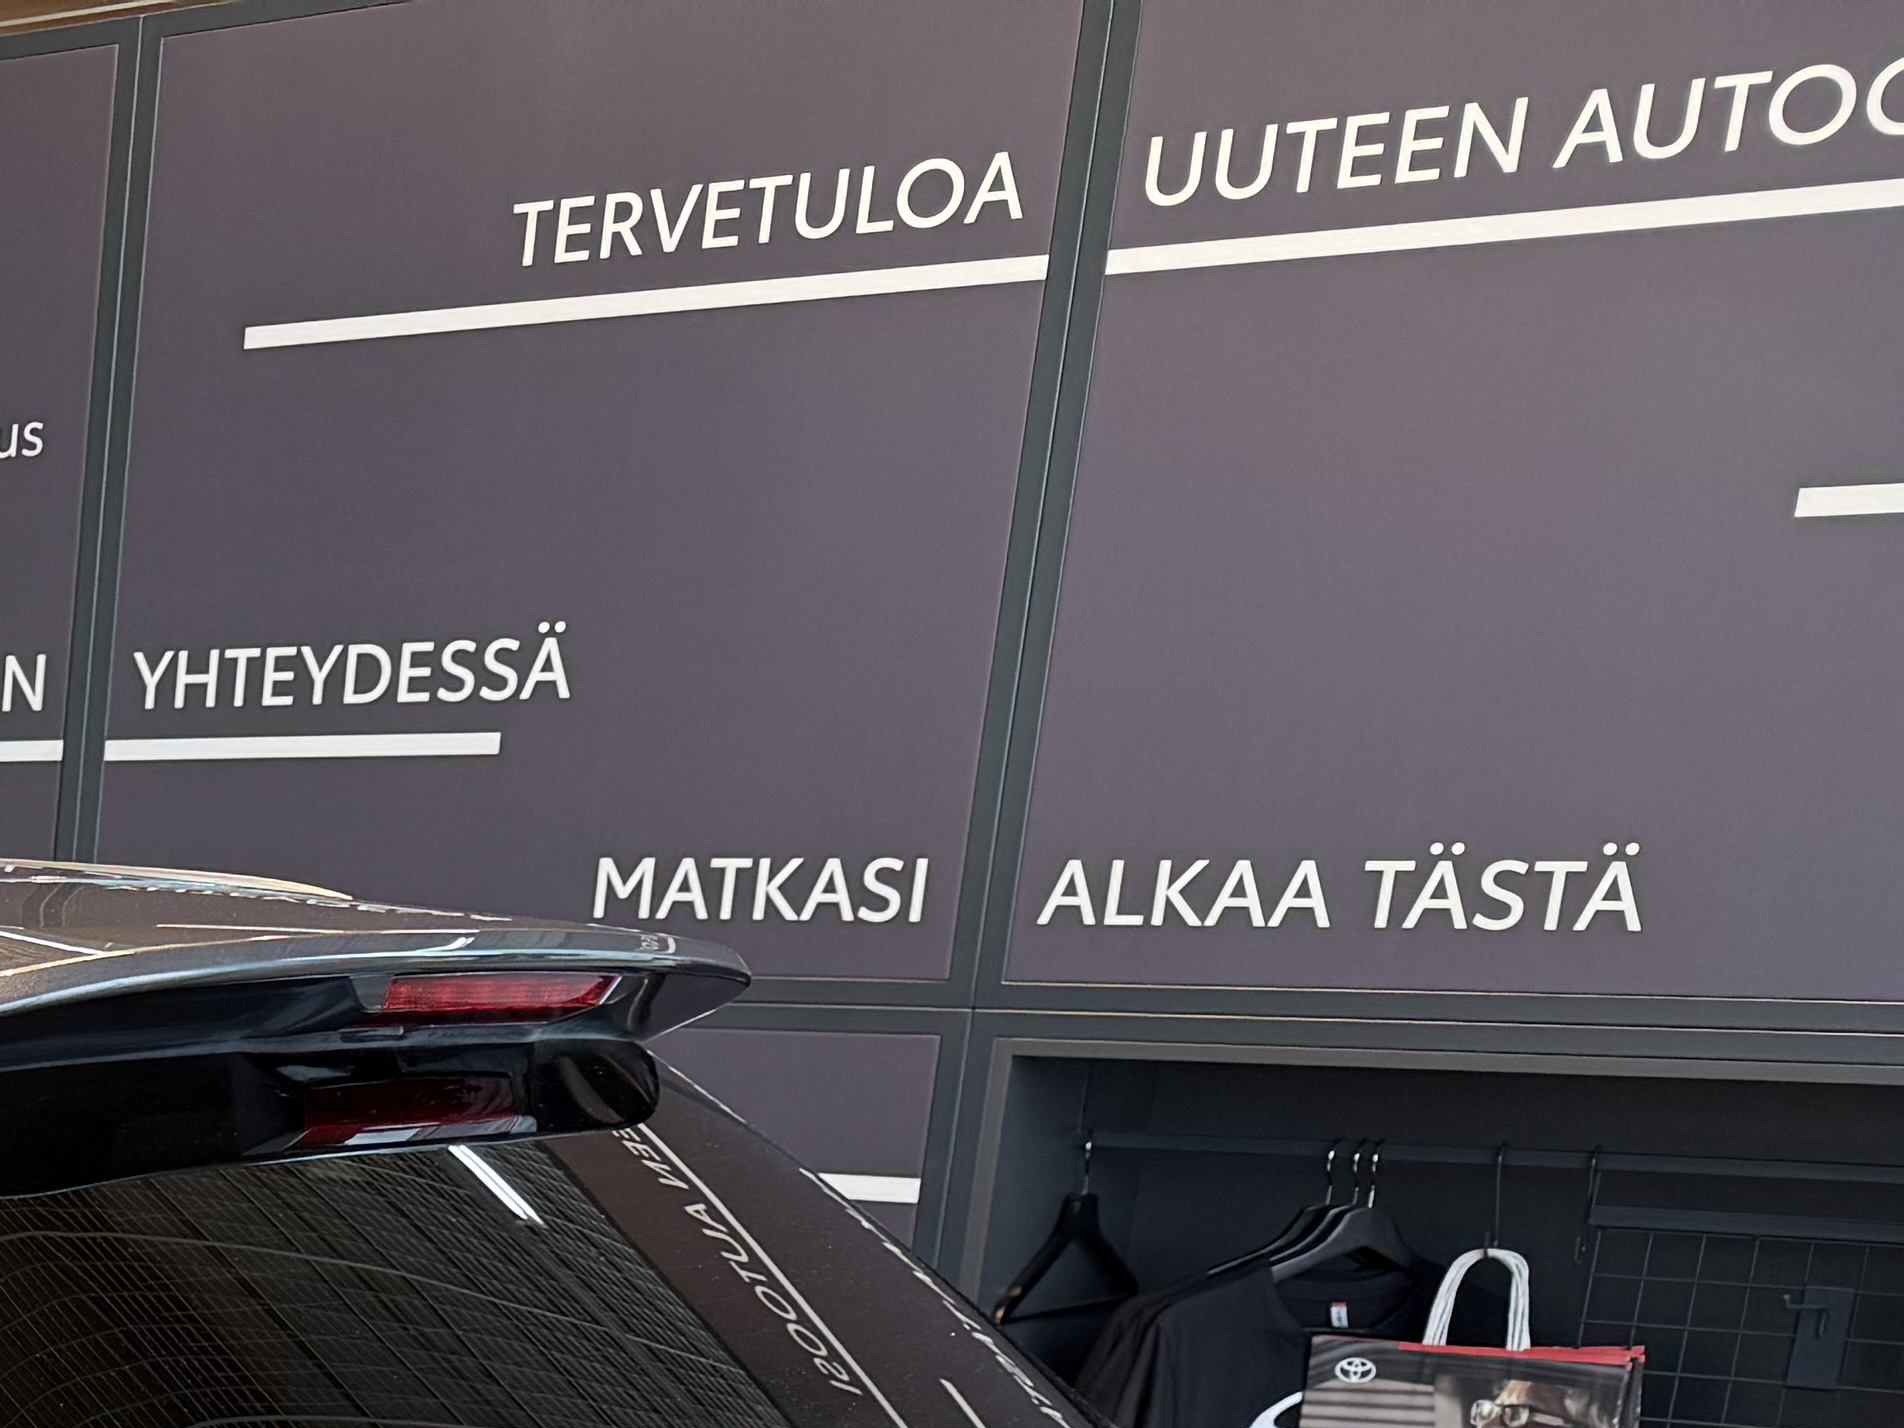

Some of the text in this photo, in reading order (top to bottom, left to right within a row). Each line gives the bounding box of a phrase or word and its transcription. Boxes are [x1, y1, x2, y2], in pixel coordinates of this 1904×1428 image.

[512, 151, 1023, 268] TERVETULOA
[1144, 96, 1529, 206] UUTEEN
[133, 620, 572, 710] YHTEYDESSÄ
[588, 842, 1643, 932] MATKASI ALKAA TÄSTÄ
